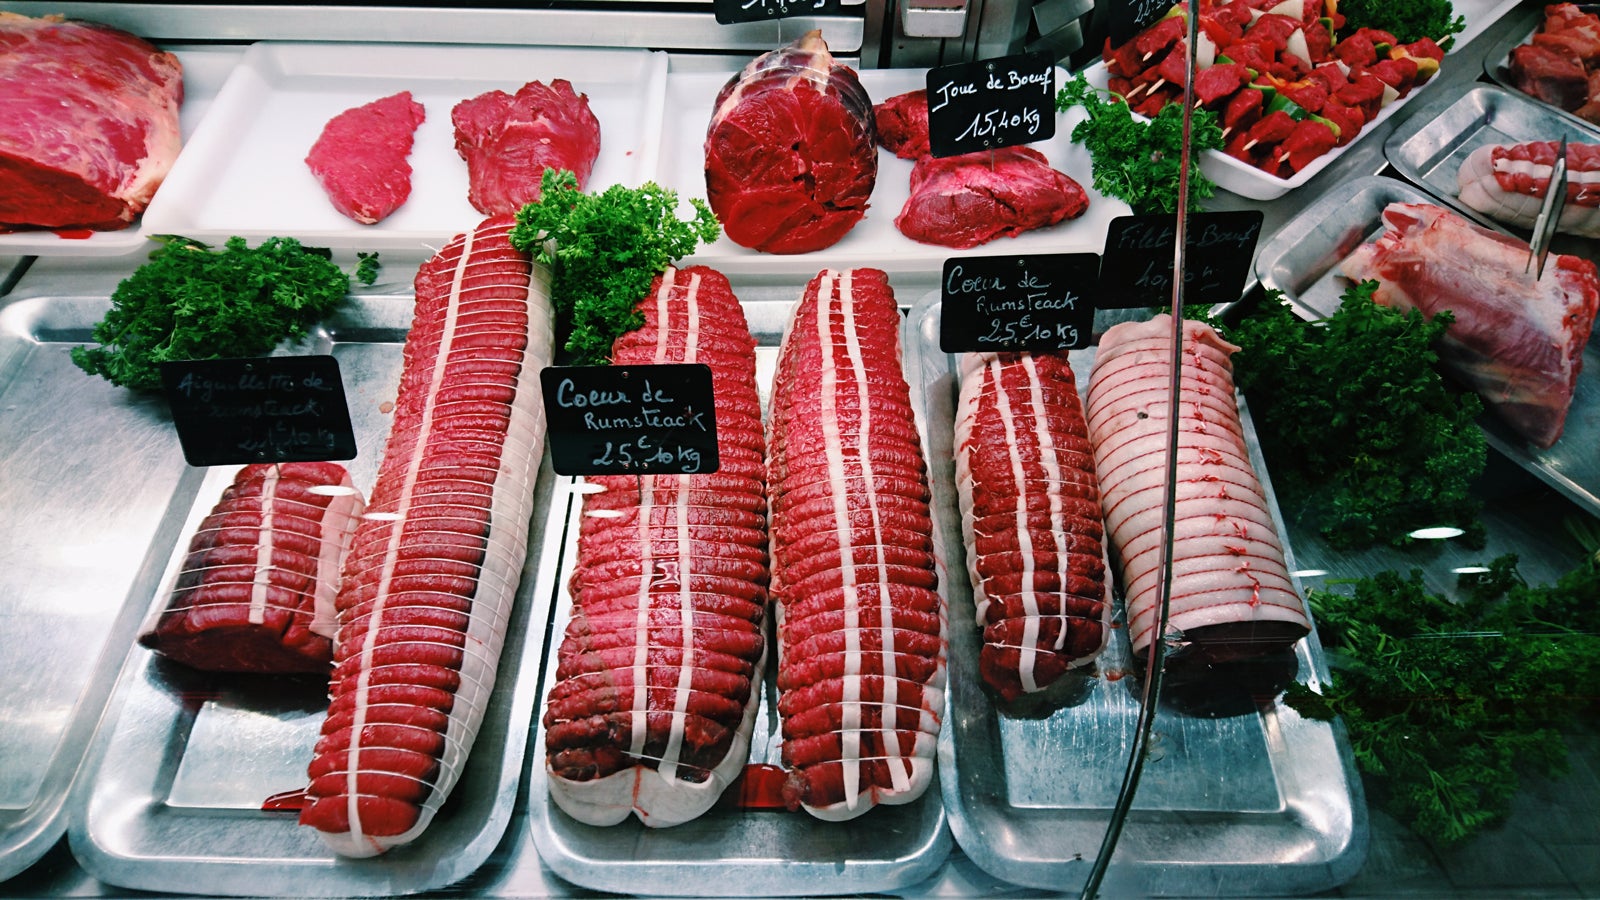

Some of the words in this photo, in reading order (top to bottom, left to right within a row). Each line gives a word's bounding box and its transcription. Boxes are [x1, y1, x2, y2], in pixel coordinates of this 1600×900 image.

[932, 81, 977, 112] Joue
[986, 74, 1004, 89] de
[1008, 67, 1053, 94] Boeuf
[1118, 222, 1174, 248] Filet
[947, 265, 1006, 295] Coeur
[1017, 270, 1052, 288] de
[302, 371, 334, 392] de
[557, 378, 631, 408] Coeur
[642, 379, 674, 402] de
